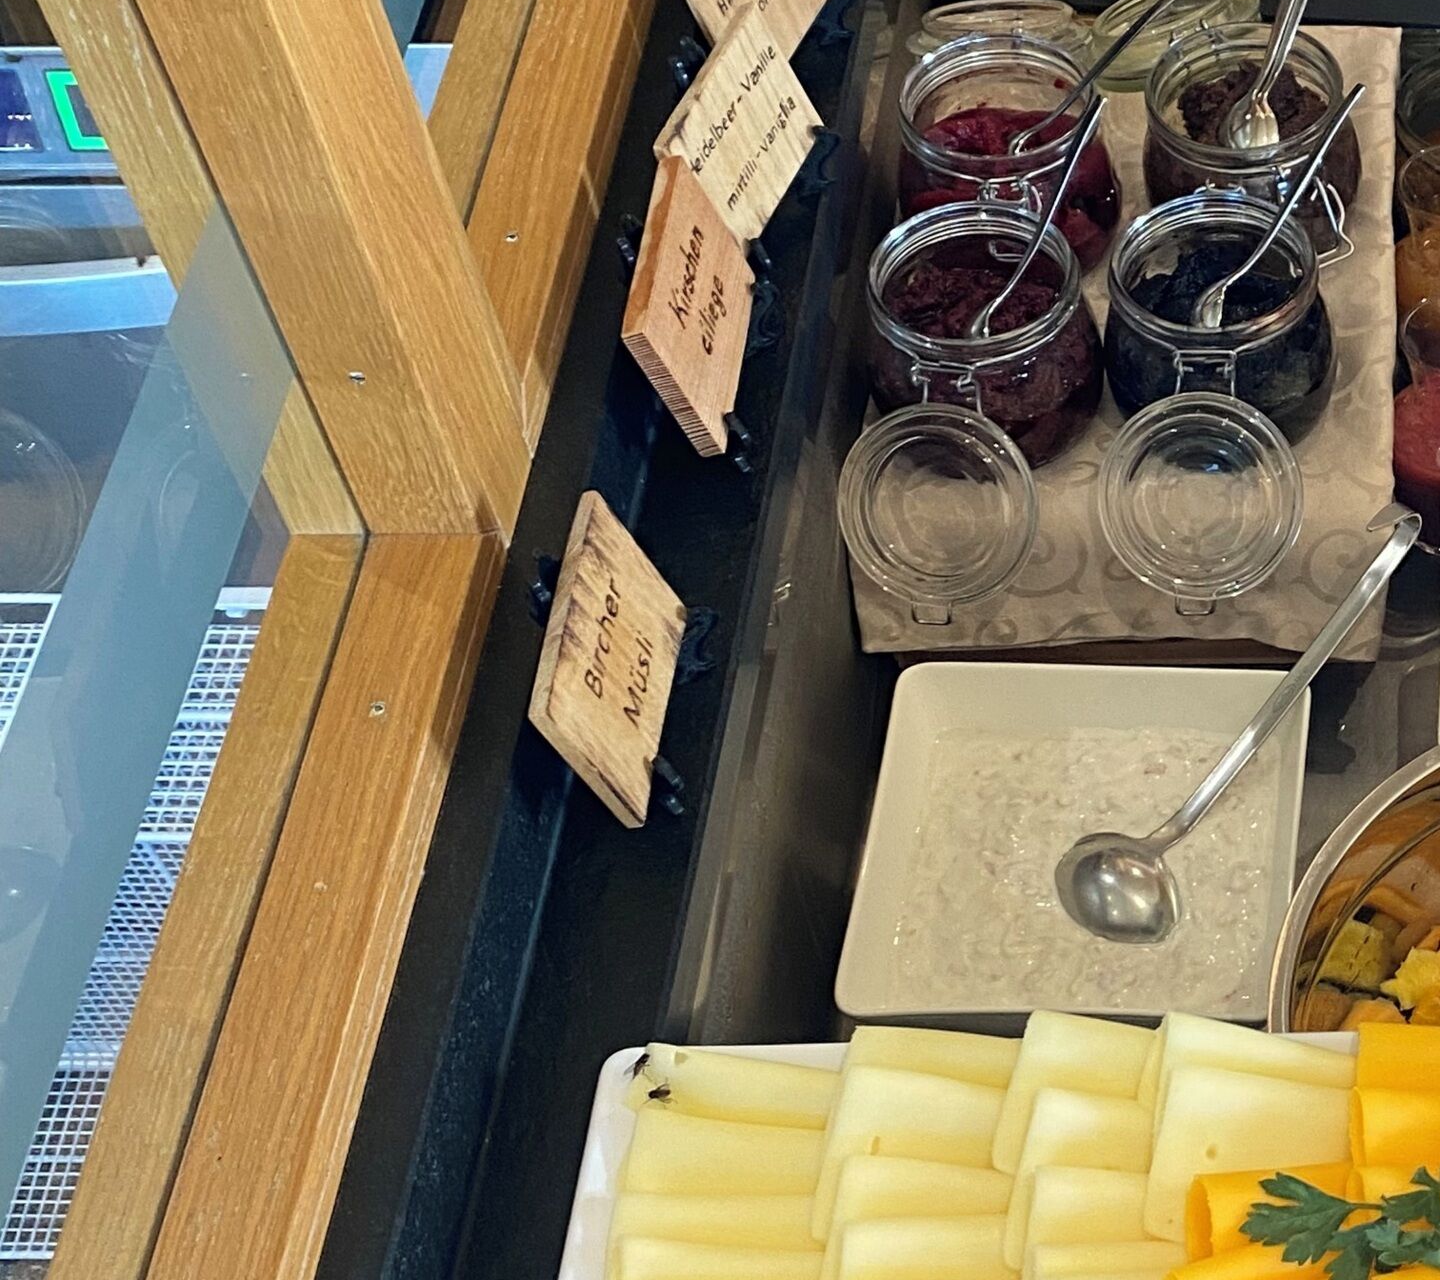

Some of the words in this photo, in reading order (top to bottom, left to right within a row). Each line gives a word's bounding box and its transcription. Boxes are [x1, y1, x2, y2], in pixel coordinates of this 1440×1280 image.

[740, 45, 776, 93] Vanille
[668, 224, 704, 330] Kirschen
[699, 274, 727, 356] ciliege
[584, 577, 621, 700] Bircher
[623, 629, 653, 730] Müsli
